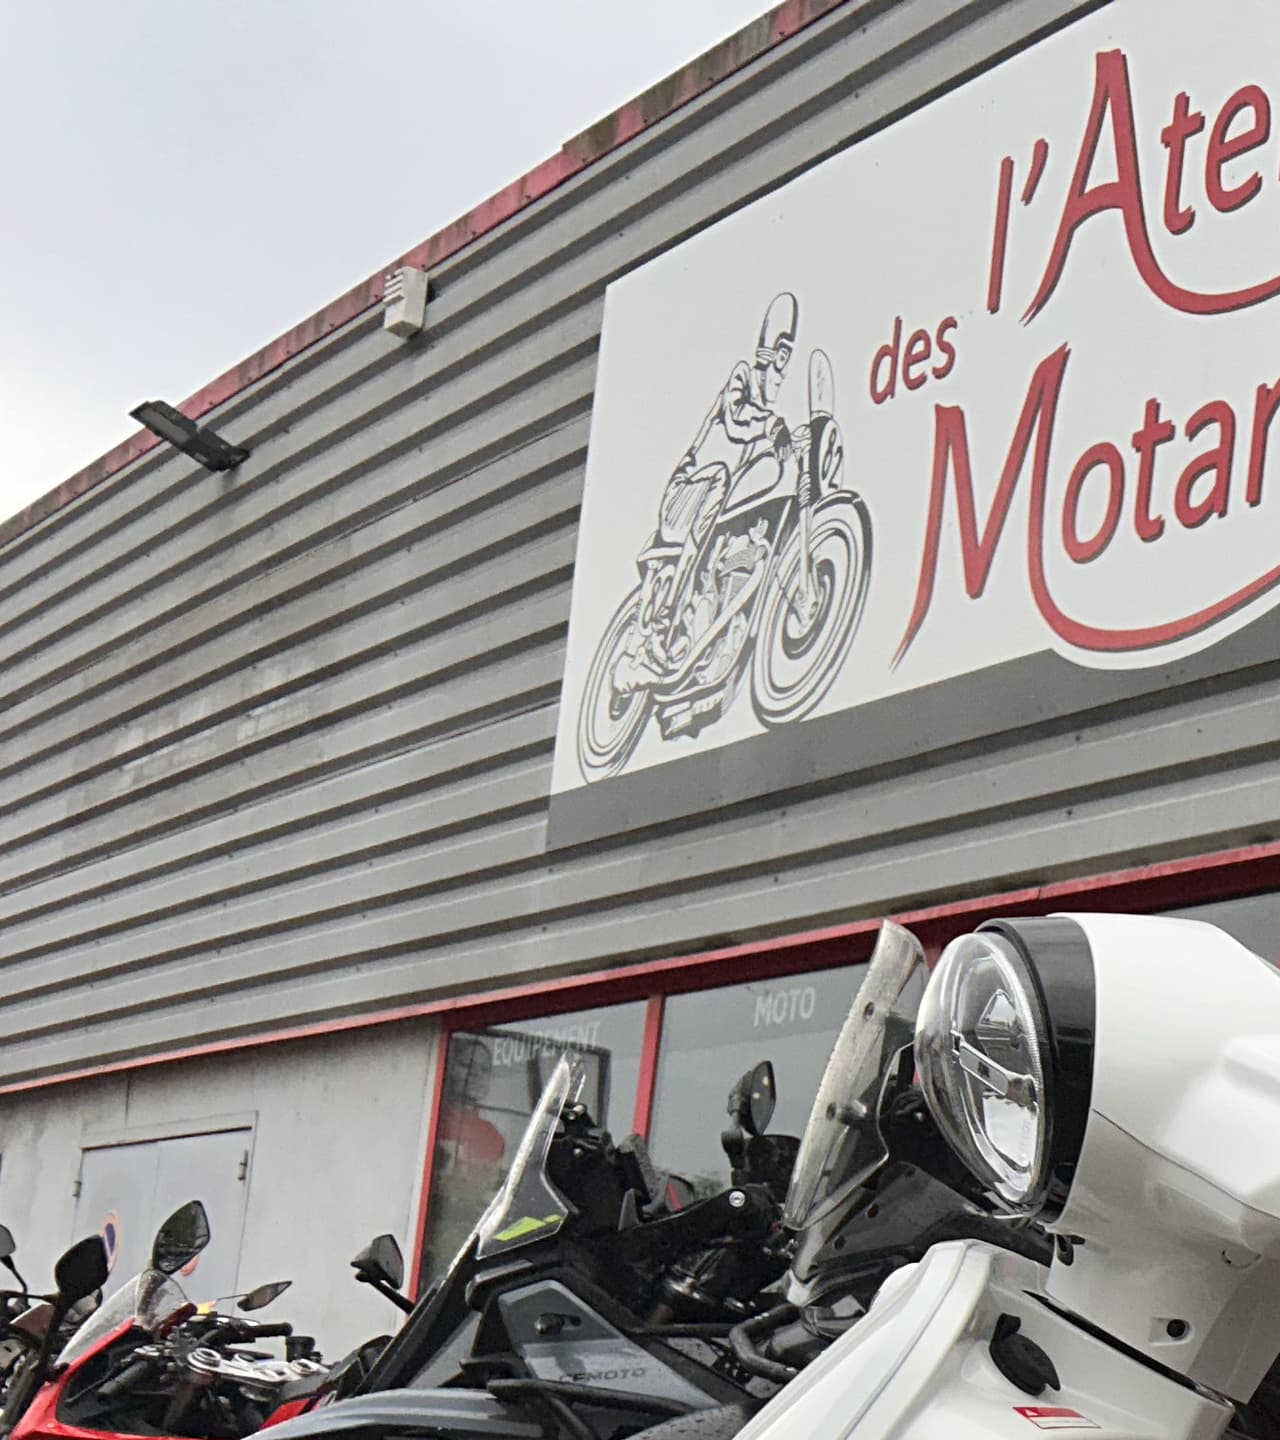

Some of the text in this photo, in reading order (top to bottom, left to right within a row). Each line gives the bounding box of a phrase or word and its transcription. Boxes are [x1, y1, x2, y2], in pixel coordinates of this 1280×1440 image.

[868, 311, 958, 404] des
[753, 986, 817, 1028] MOTO
[492, 1021, 602, 1067] EQUIPEMENT
